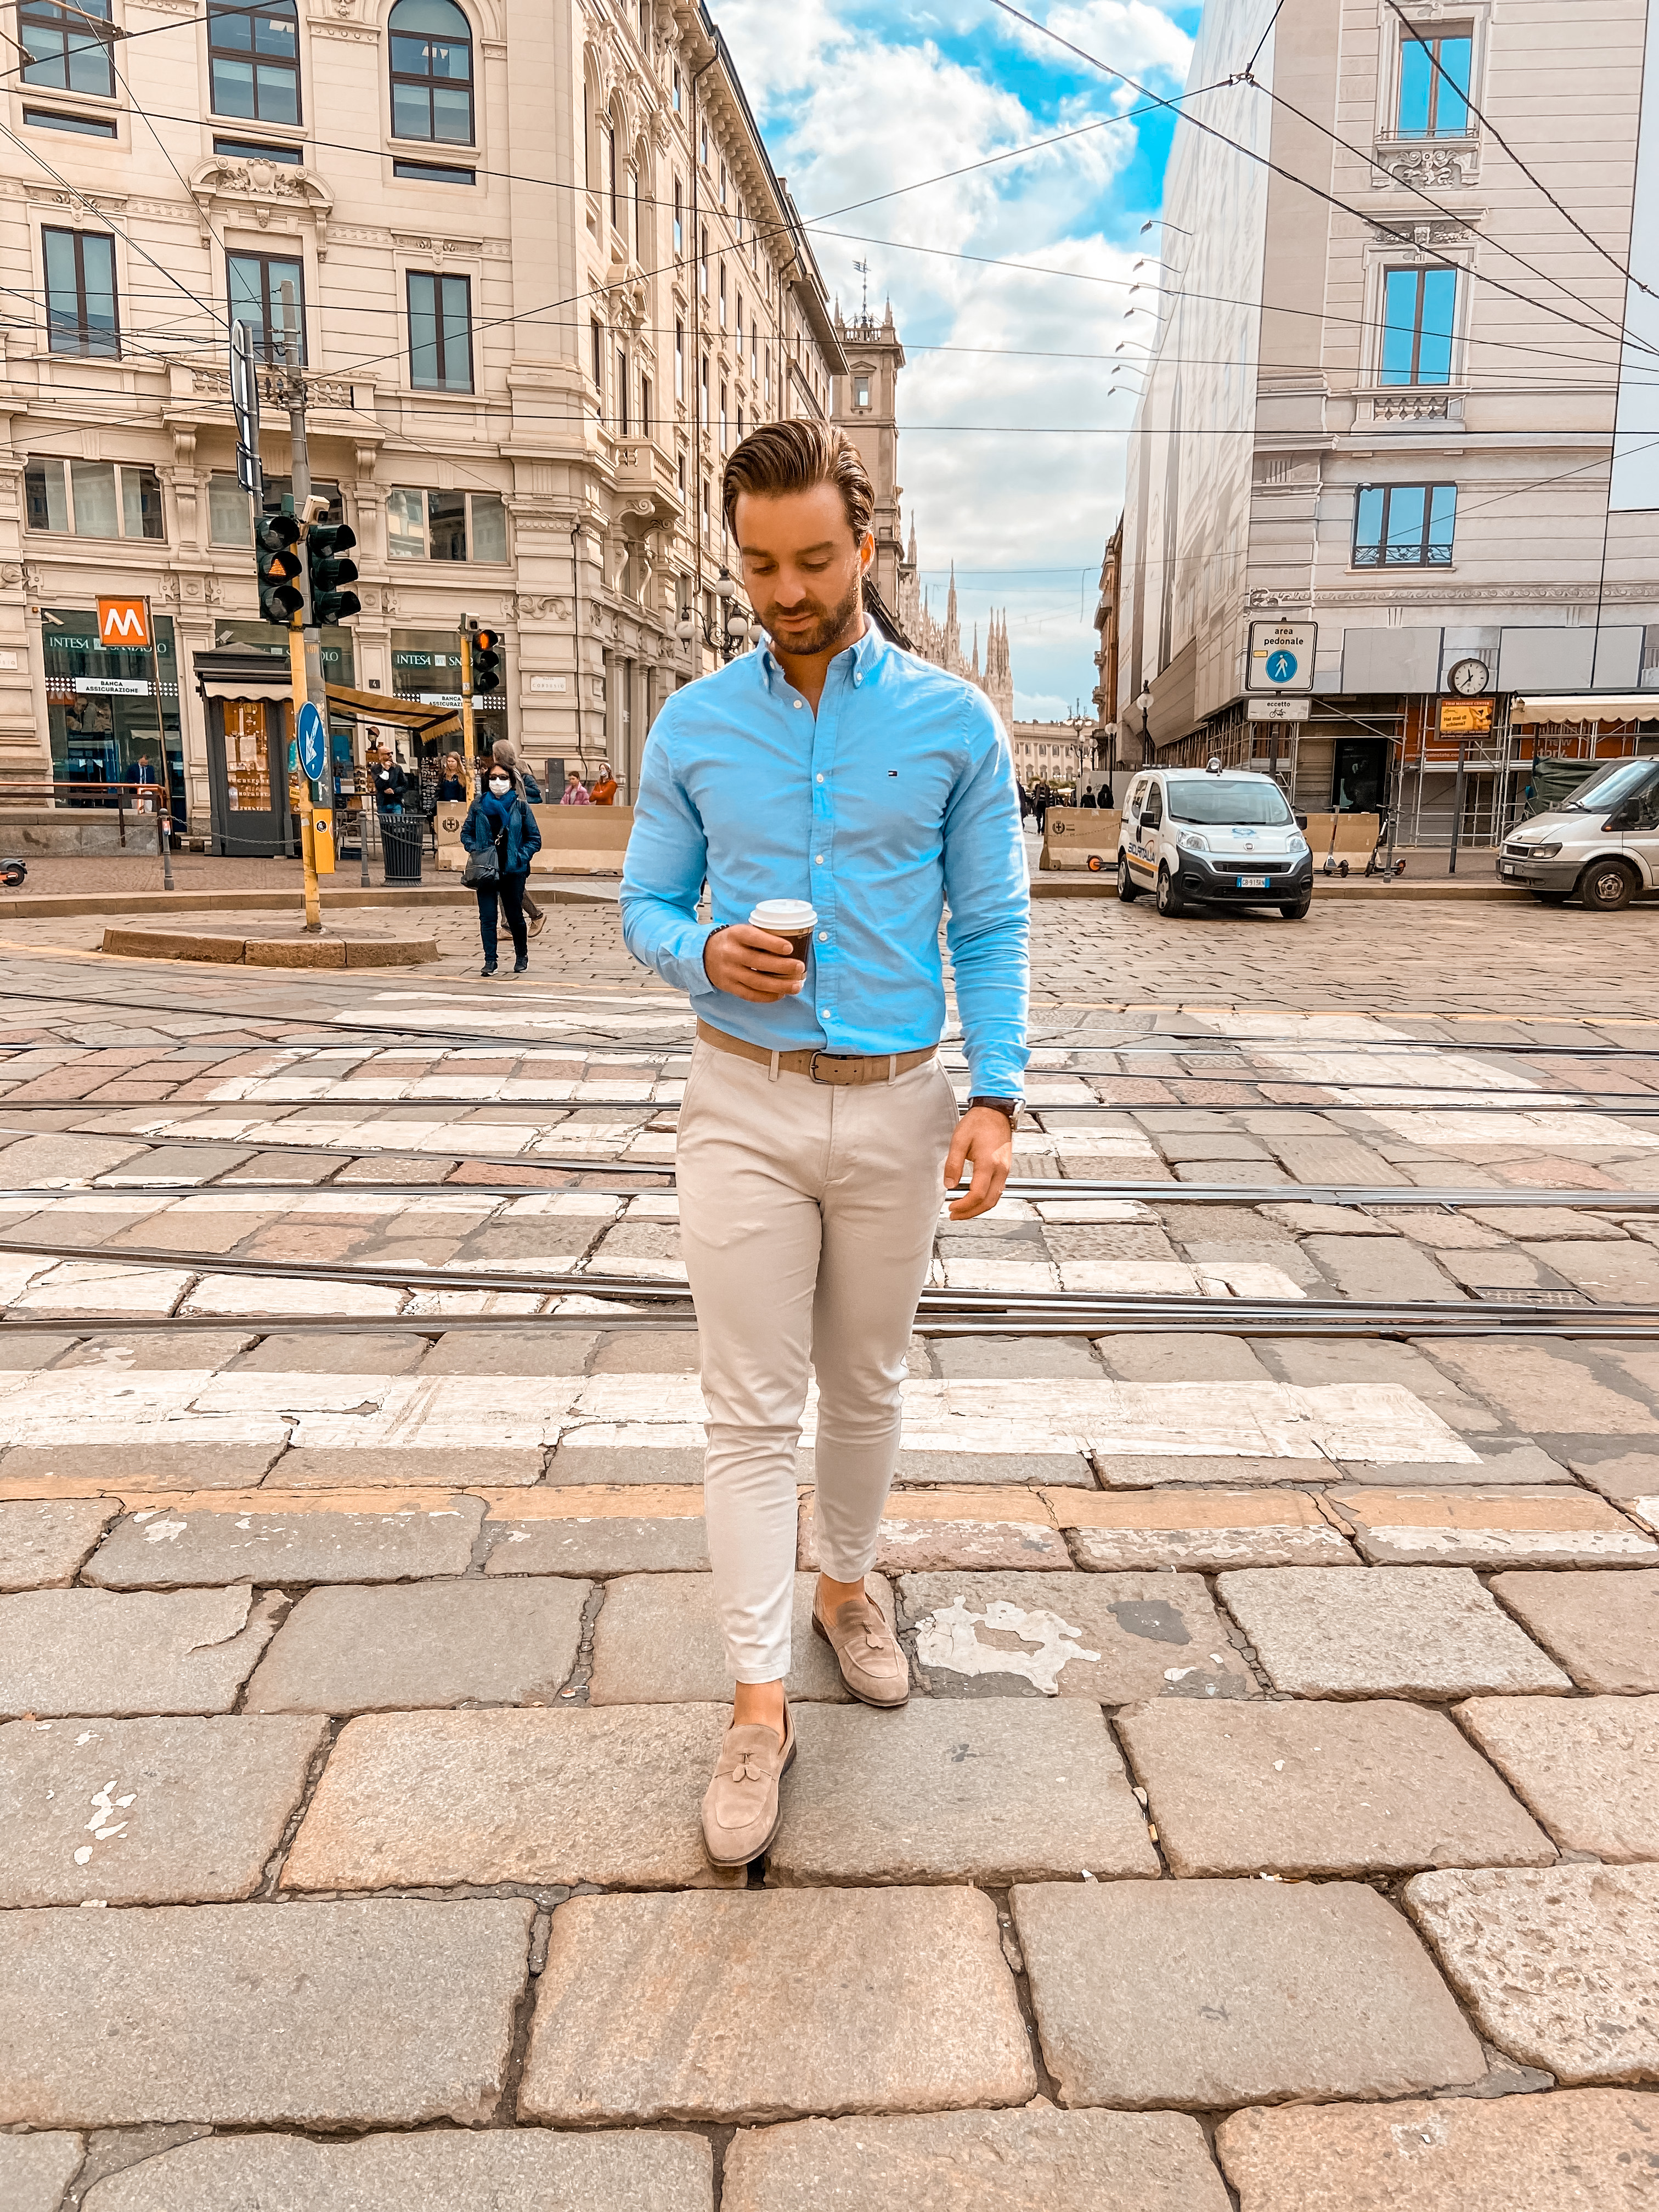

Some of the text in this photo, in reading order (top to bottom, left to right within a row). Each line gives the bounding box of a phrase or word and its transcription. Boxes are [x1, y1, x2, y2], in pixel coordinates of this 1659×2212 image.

[104, 608, 144, 636] M
[50, 637, 89, 649] INTESA
[1264, 637, 1304, 646] pedonale
[397, 654, 432, 665] INTESA
